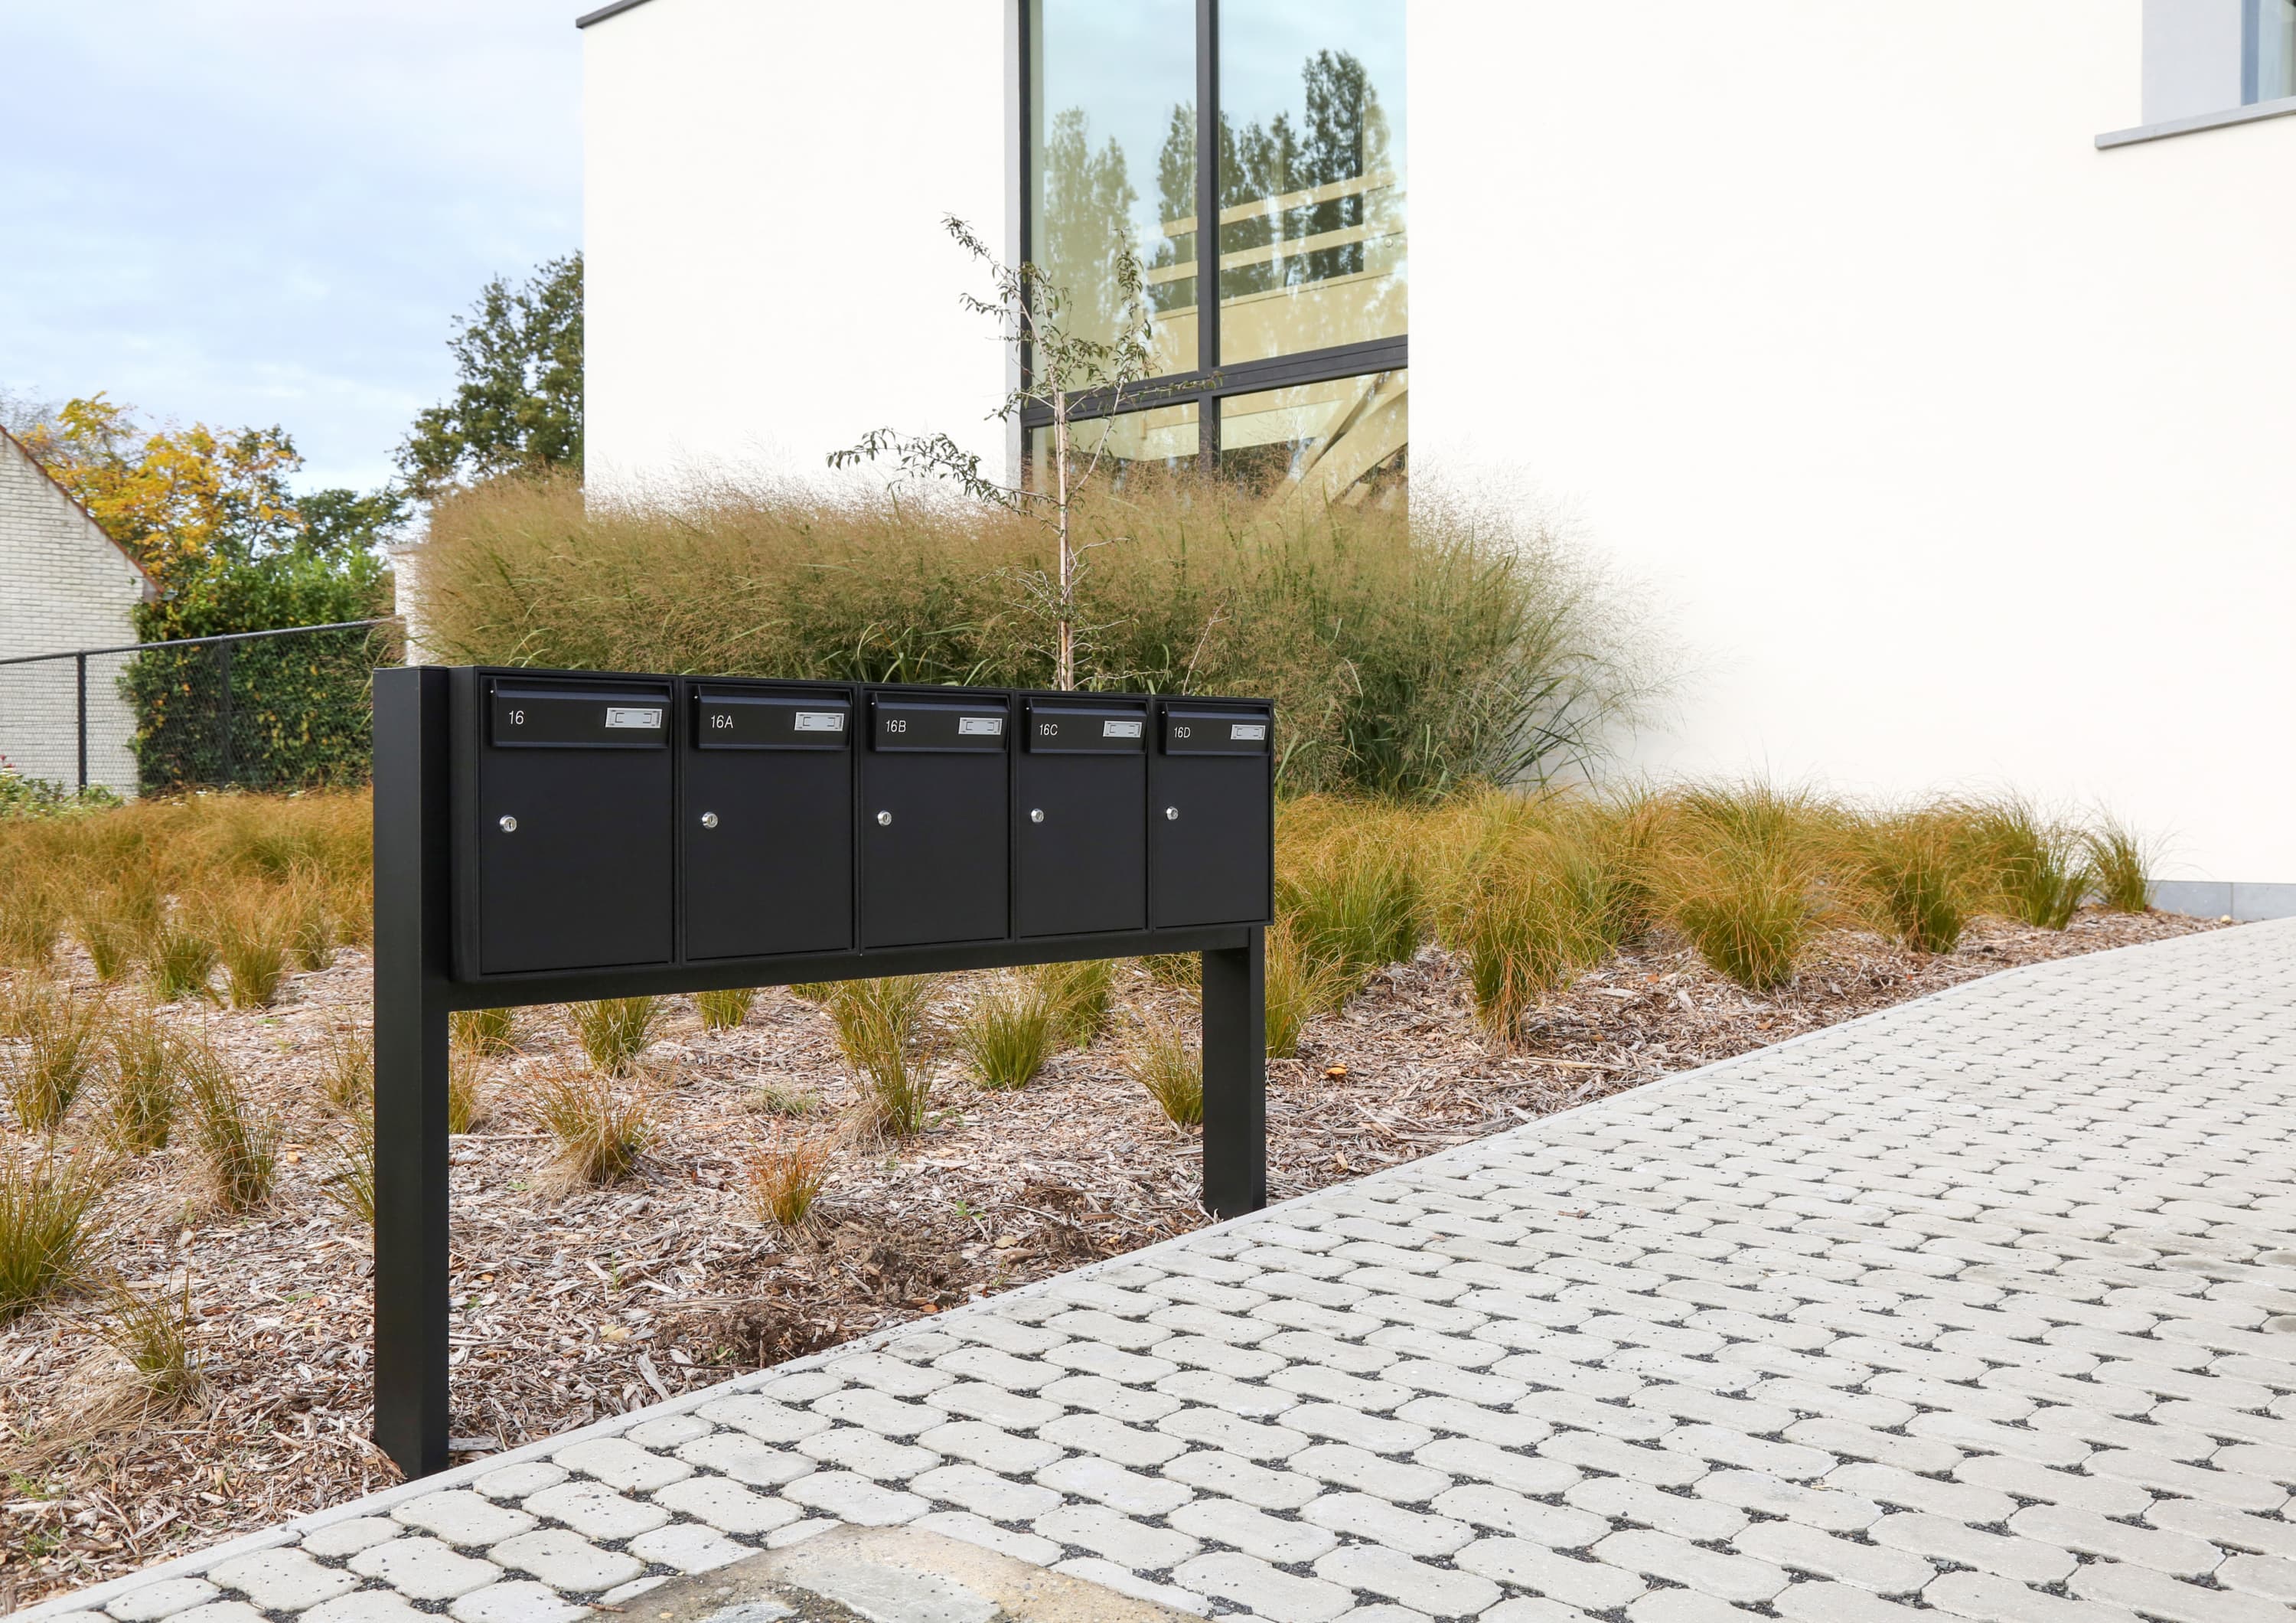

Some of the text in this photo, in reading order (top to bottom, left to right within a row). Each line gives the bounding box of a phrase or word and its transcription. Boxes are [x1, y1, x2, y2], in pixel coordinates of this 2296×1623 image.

[508, 710, 524, 725] 16
[710, 714, 734, 729] 16A
[885, 719, 906, 733] 16B
[1039, 723, 1058, 736] 16C
[1173, 726, 1191, 739] 16D
